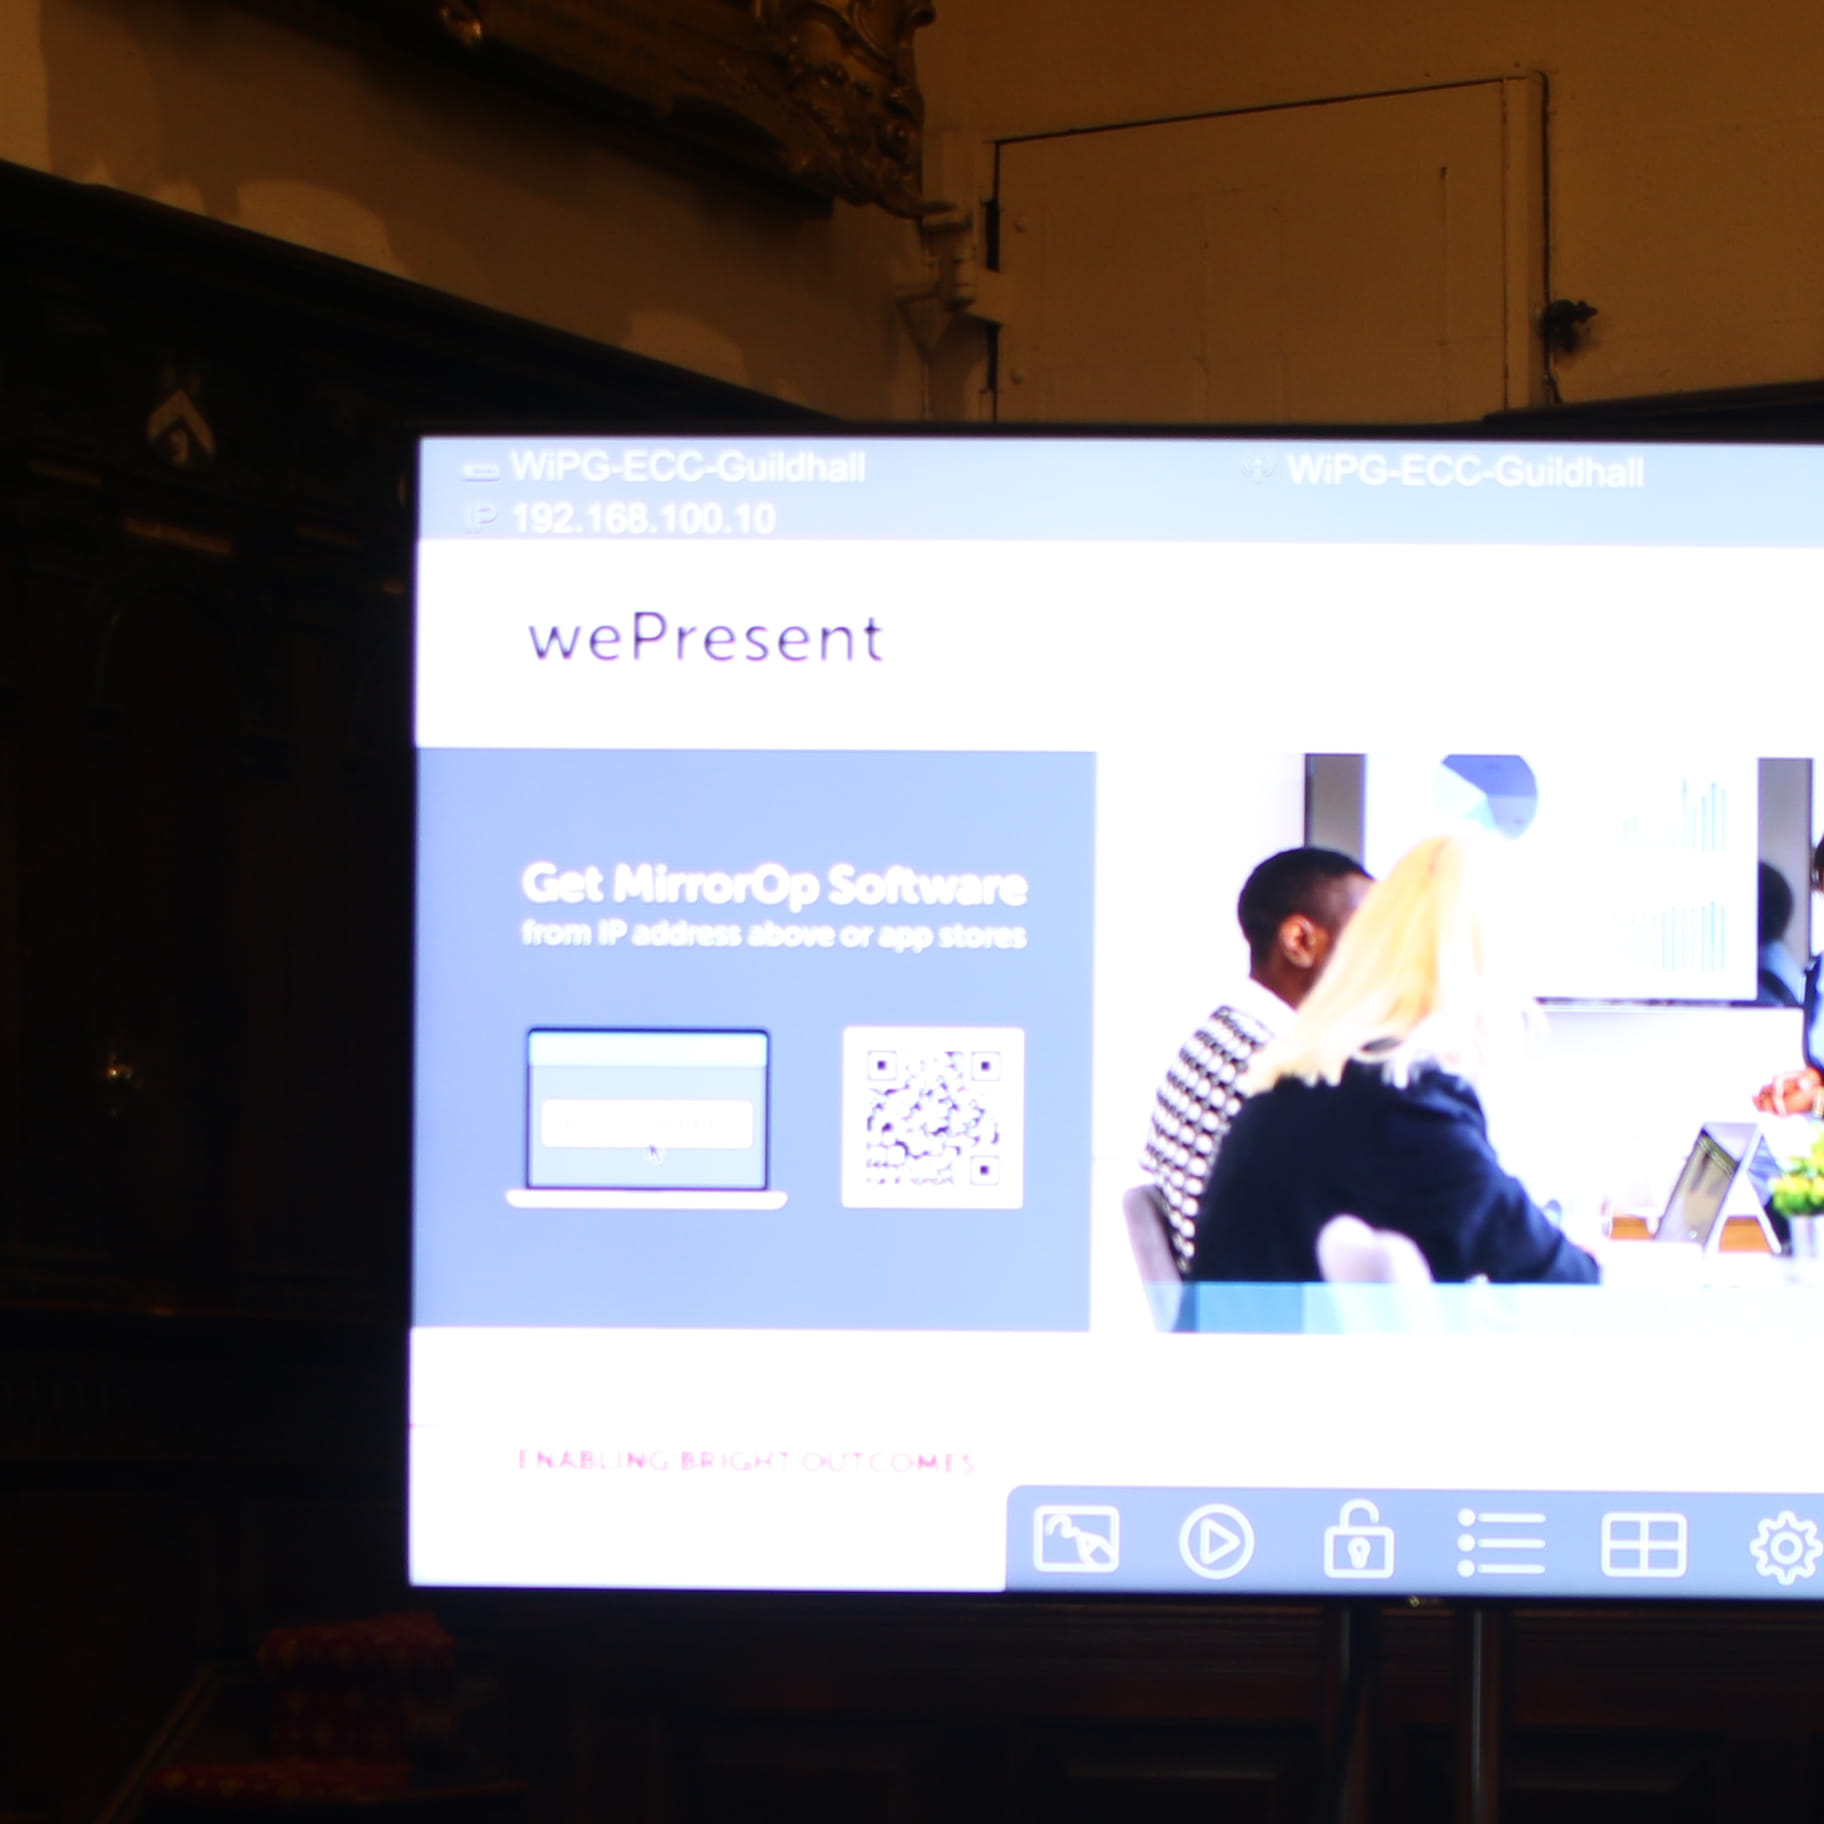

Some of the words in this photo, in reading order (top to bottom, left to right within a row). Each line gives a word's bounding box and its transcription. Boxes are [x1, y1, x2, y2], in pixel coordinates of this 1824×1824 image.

[511, 449, 866, 483] WiPG-ECC-Guildhall
[1287, 453, 1644, 489] WiPG-ECC-Guildhall
[512, 501, 777, 535] 192.168.100.10
[529, 611, 883, 661] wePresent
[521, 861, 604, 904] Get
[613, 861, 821, 913] MirrorOp
[828, 863, 1029, 907] Software
[521, 919, 592, 947] from
[598, 919, 628, 947] IP
[631, 920, 743, 948] address
[747, 920, 836, 949] above
[839, 926, 875, 949] or
[877, 925, 934, 954] app
[938, 922, 1028, 950] stores
[518, 1448, 670, 1472] ENABLING
[680, 1449, 791, 1473] BRIGHT
